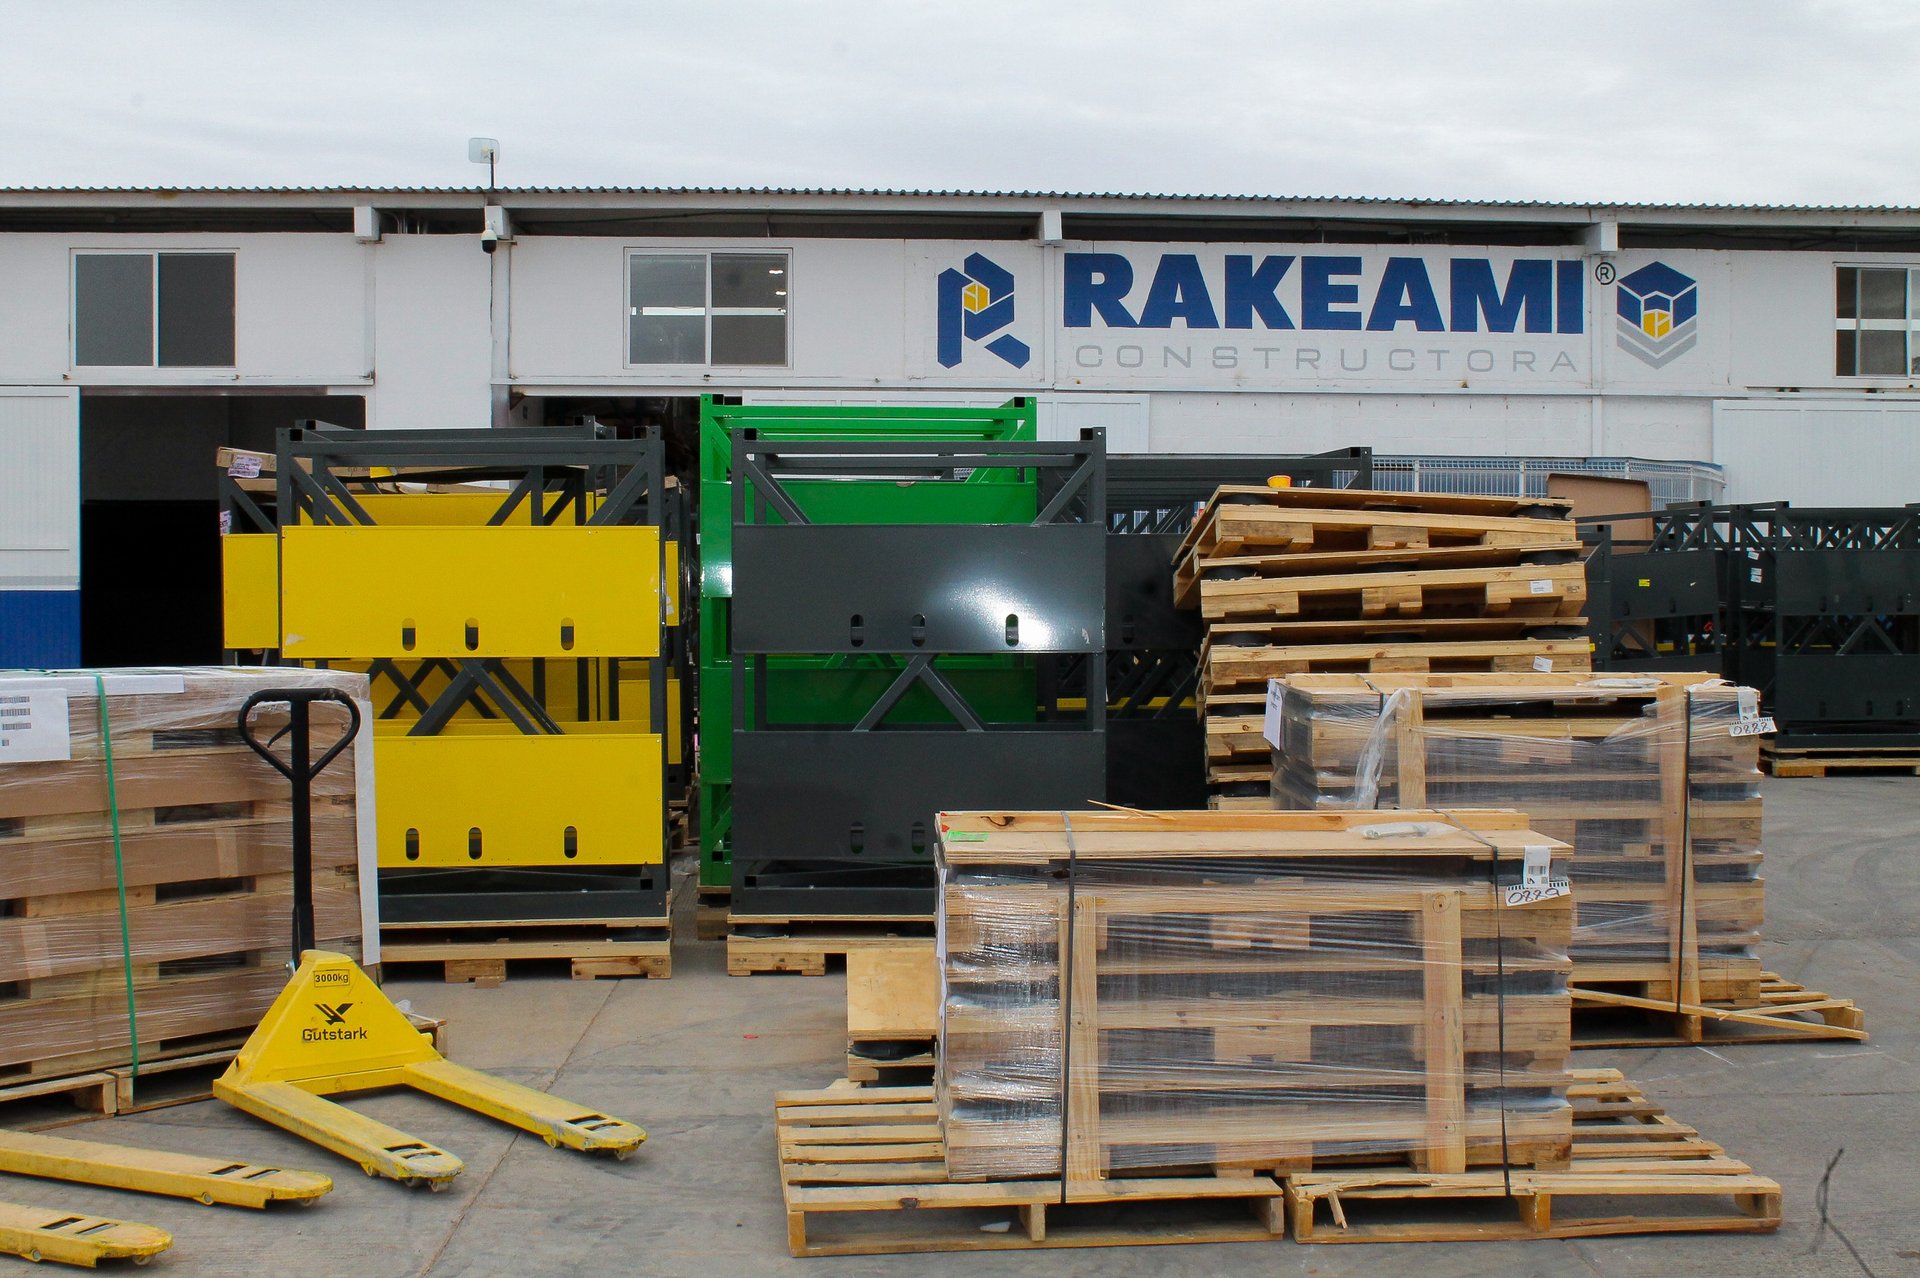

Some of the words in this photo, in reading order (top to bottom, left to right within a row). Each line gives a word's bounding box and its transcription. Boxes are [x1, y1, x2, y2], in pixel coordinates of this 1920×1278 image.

[1063, 253, 1584, 334] RAKEAMI
[1075, 344, 1578, 373] CONSTRUCTORA
[315, 973, 349, 983] 3000kg
[302, 1027, 368, 1041] Gutstark
